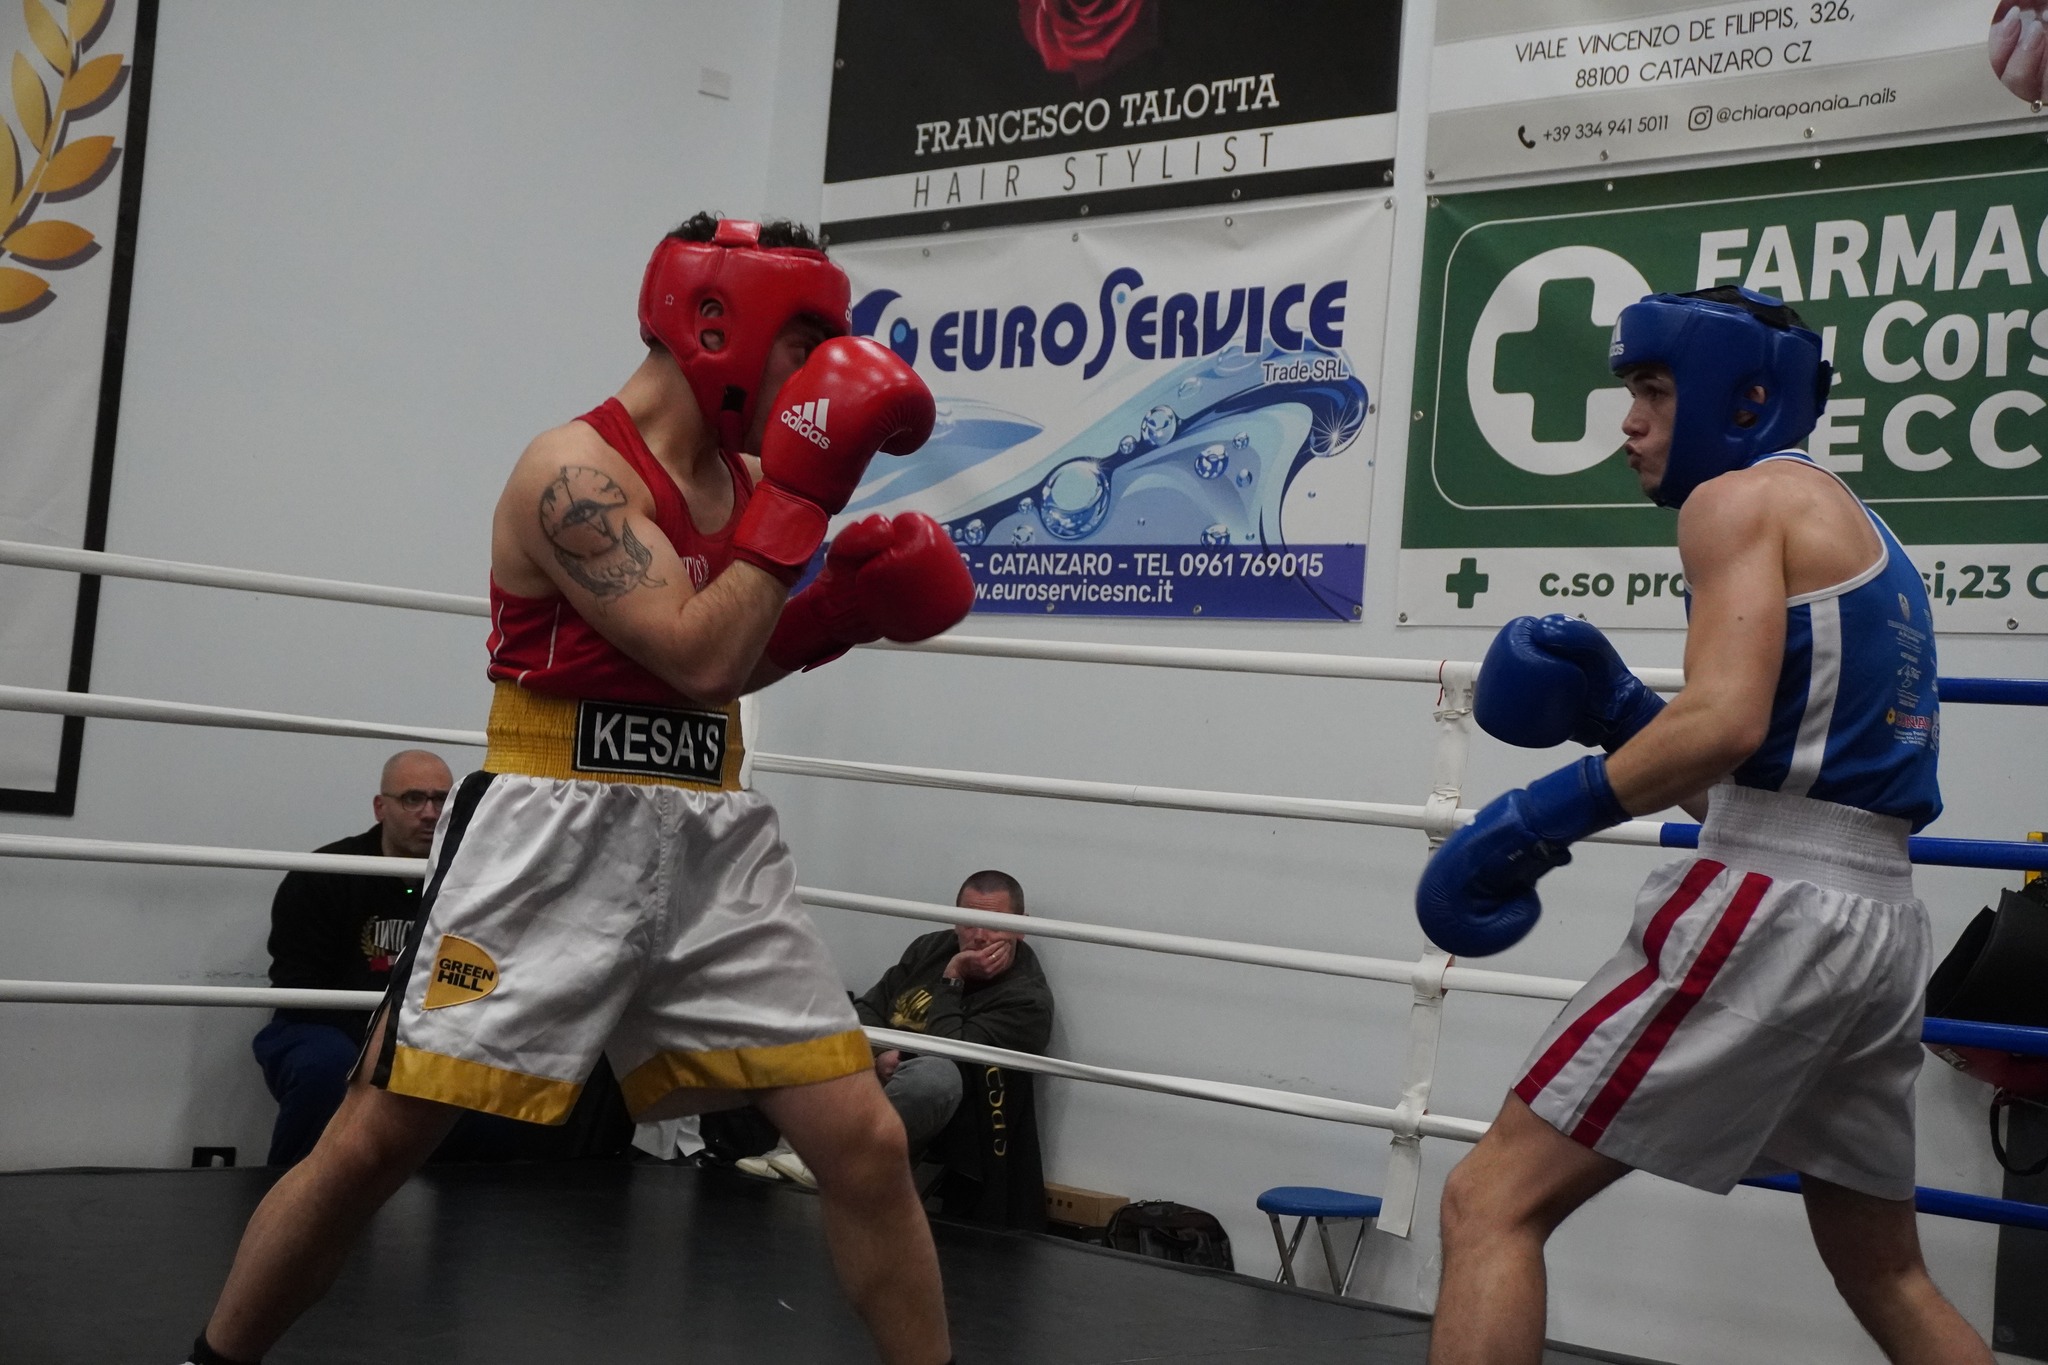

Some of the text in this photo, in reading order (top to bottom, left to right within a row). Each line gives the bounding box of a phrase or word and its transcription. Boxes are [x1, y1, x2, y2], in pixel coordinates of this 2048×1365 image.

[1515, 0, 1855, 63] VIALE VINCENZO DE FILIPPIS, 326,
[1575, 40, 1813, 89] 88100 CATANZARO CZ
[914, 73, 1280, 156] FRANCESCO TALOTTA
[1716, 87, 1897, 124] @chiarapanaia_nails
[1543, 115, 1669, 143] +39 334 941 5011
[913, 131, 1274, 208] HAIR STYLIST
[1696, 204, 2048, 302] FARMA
[1262, 358, 1348, 383] Trade SRL
[780, 409, 831, 450] adidas
[989, 552, 1112, 576] CATANZARO
[1134, 553, 1174, 576] TEL
[1179, 553, 1234, 577] 0961
[1240, 553, 1324, 577] 769015
[1539, 572, 1615, 597] c.so
[593, 711, 720, 771] KESA'S
[437, 969, 484, 993] HILL
[439, 957, 495, 982] GREEN
